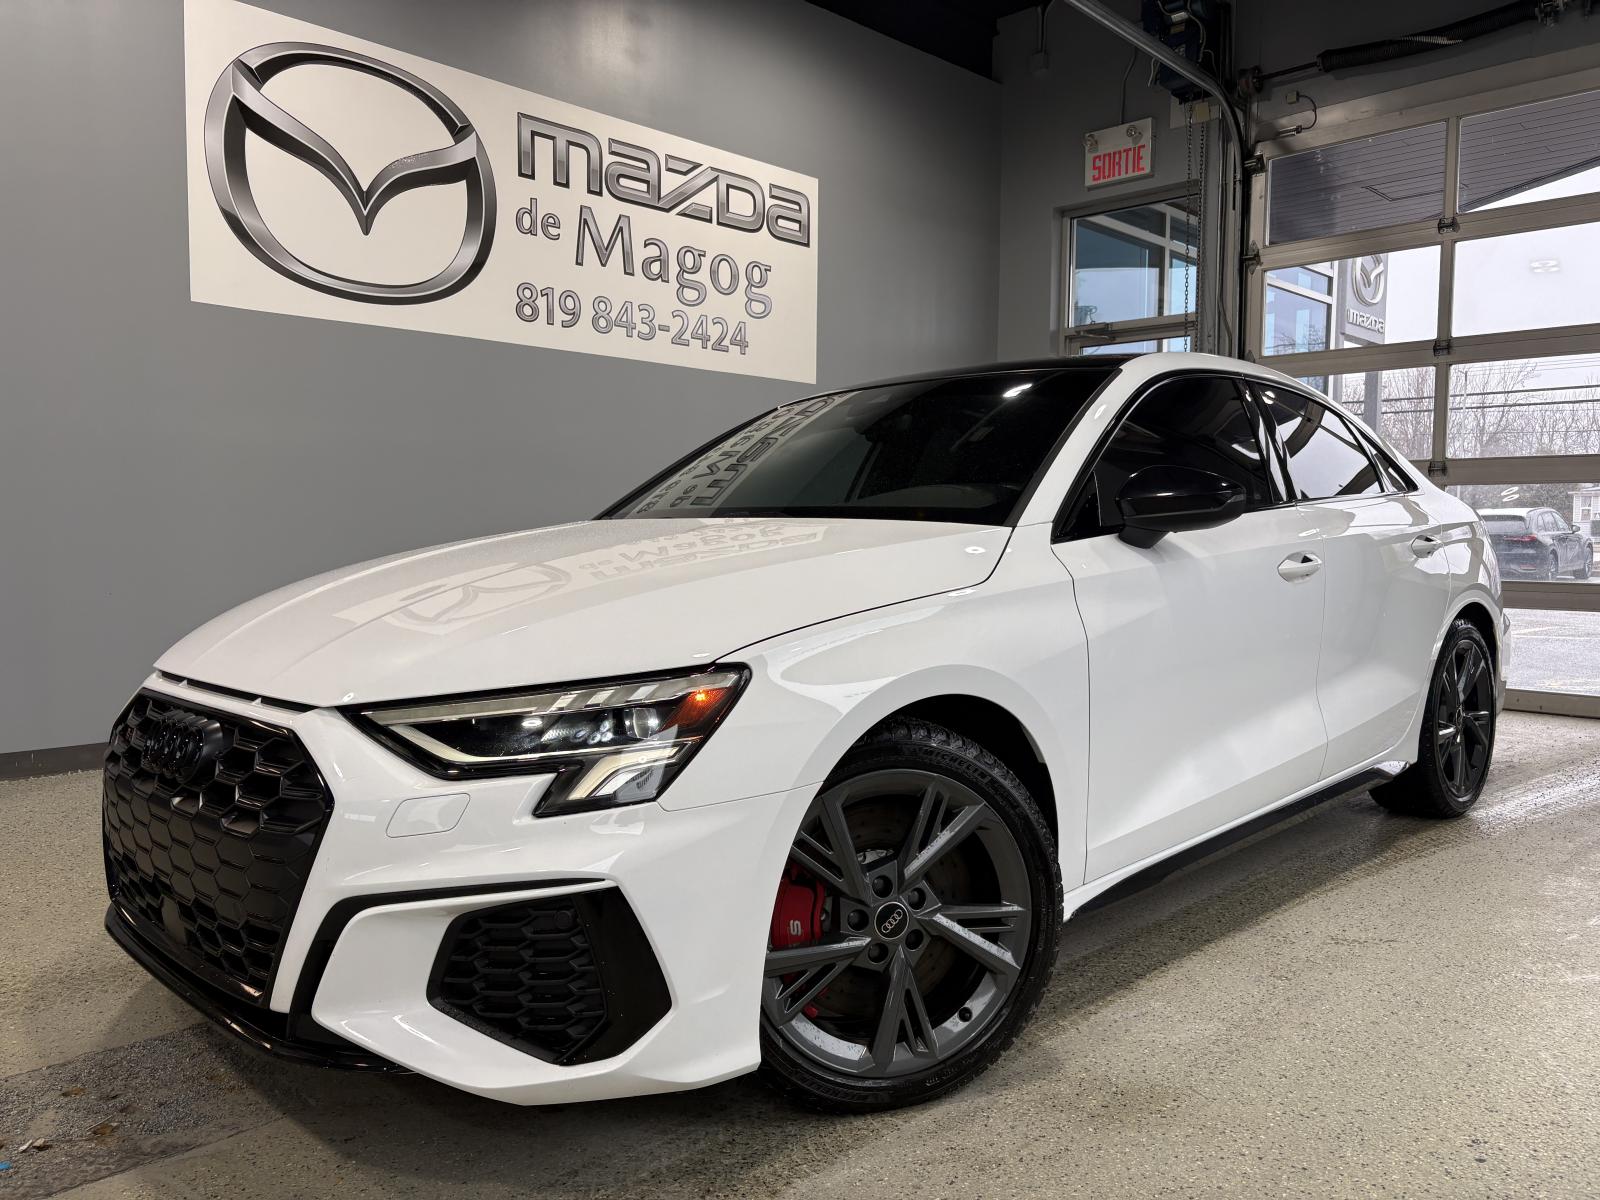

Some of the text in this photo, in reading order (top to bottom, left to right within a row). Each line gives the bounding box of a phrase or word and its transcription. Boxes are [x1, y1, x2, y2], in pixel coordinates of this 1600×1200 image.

[1091, 144, 1146, 182] SORTIE
[515, 198, 773, 319] de Magog
[515, 282, 749, 356] 819 843-2424
[922, 748, 992, 784] MICHELIN
[789, 919, 802, 936] S
